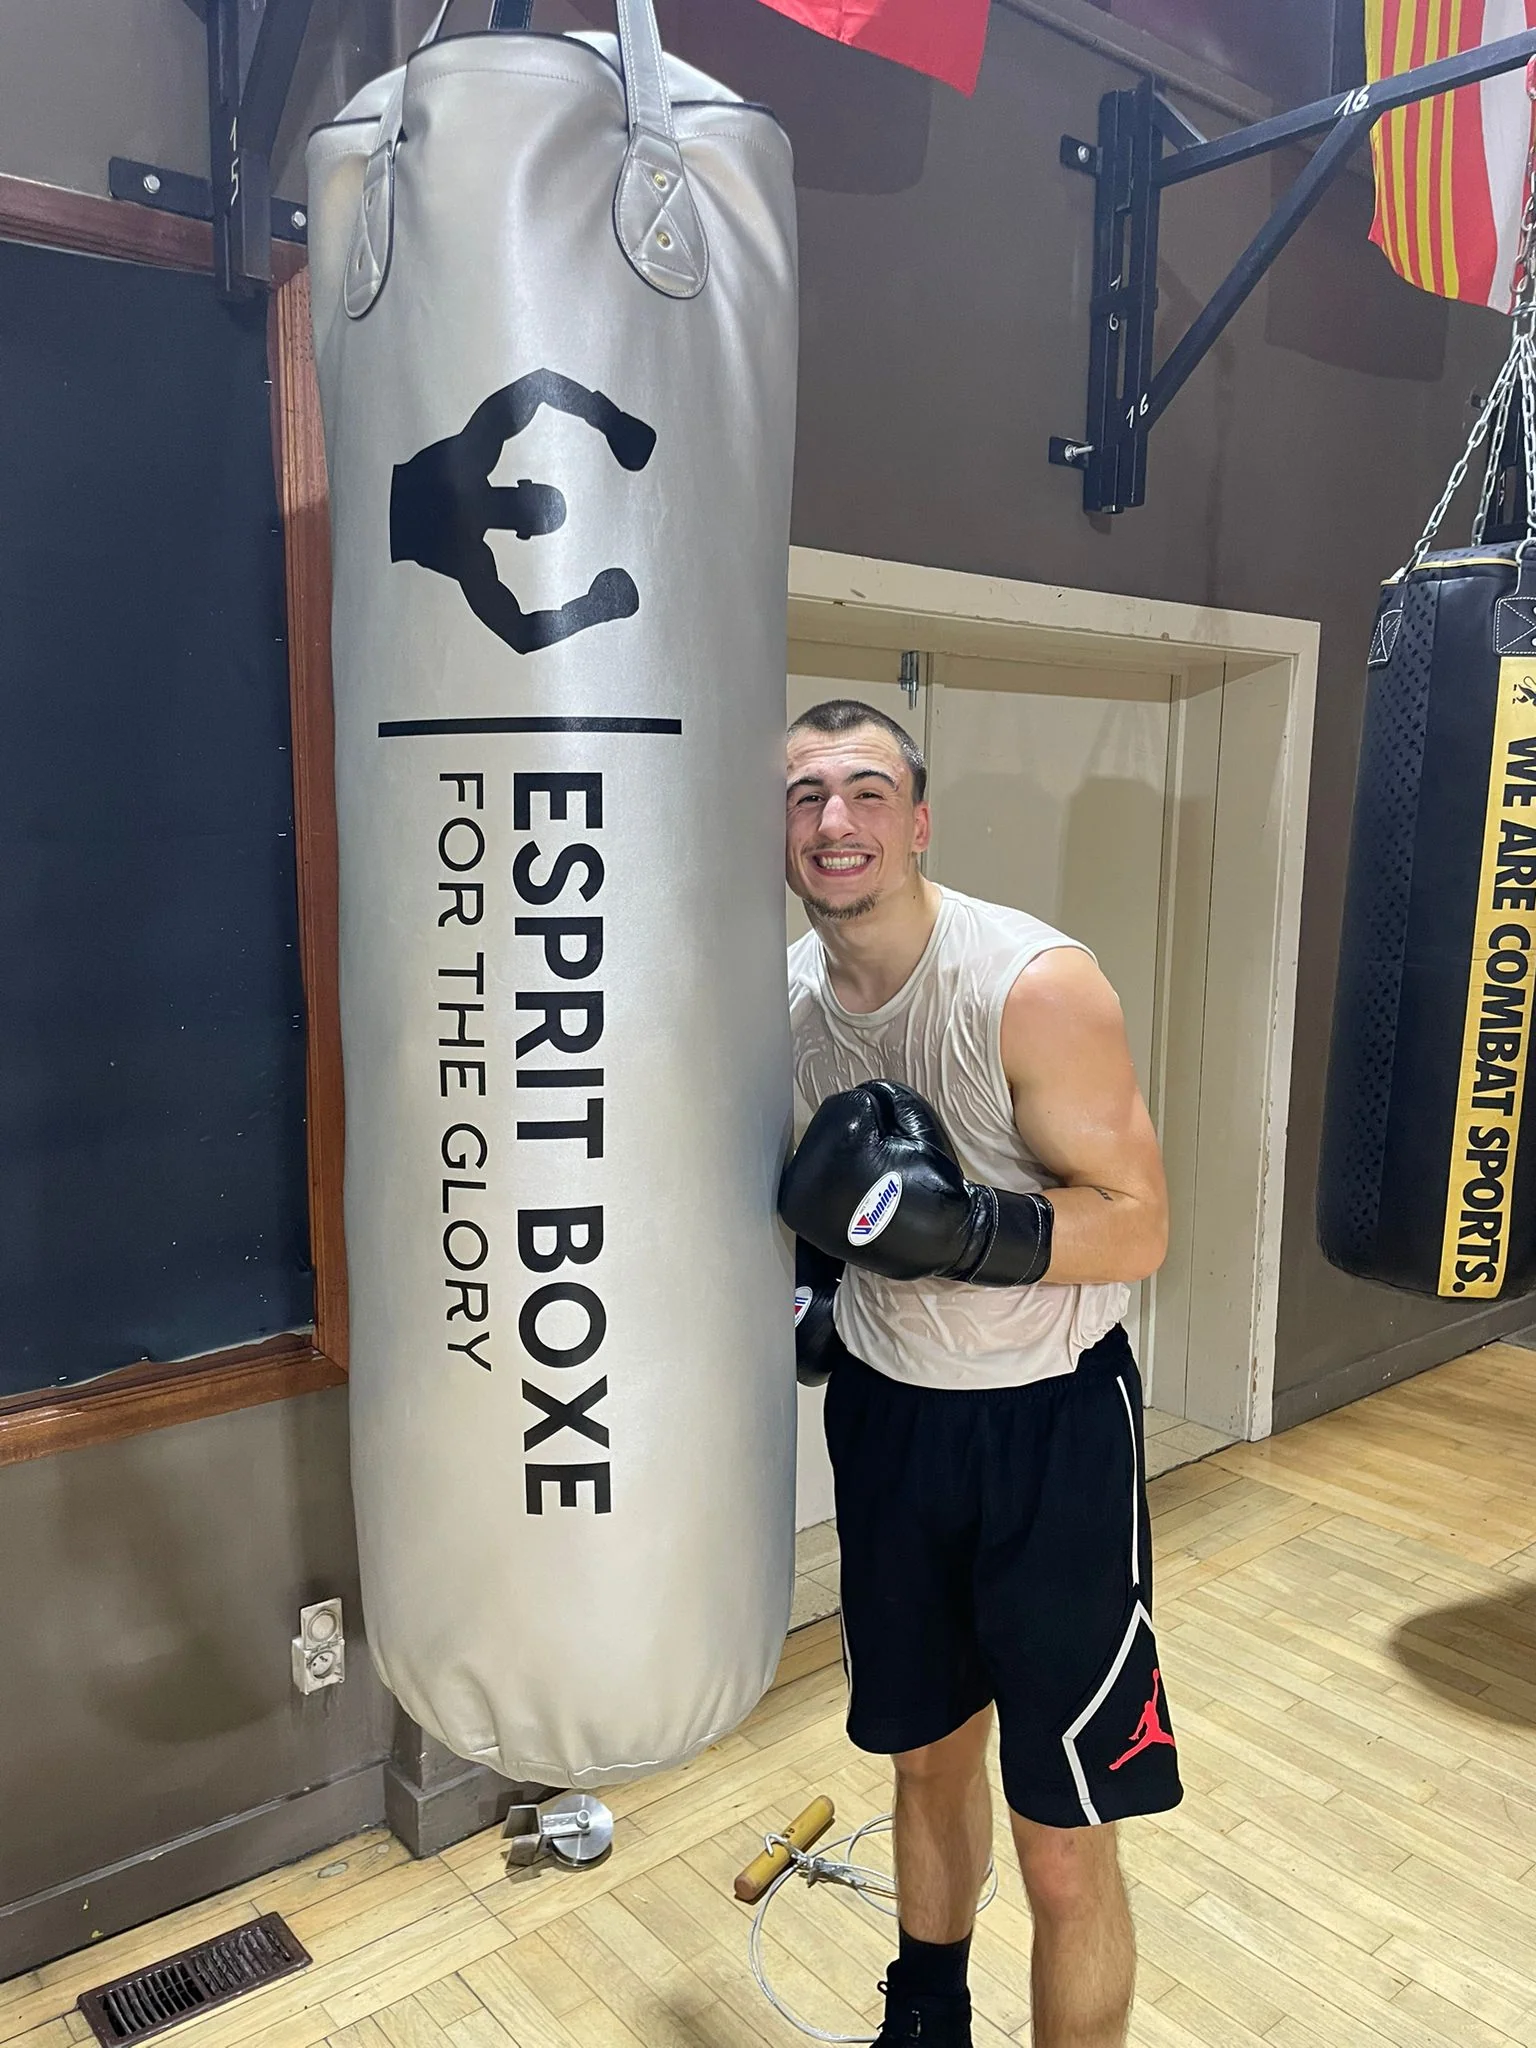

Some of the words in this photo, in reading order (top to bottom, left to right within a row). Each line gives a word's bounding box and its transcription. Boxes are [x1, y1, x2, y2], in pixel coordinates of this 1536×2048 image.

[1333, 84, 1370, 116] 16
[1126, 393, 1149, 428] 16
[438, 772, 486, 928] FOR
[1503, 737, 1536, 807] WE
[1492, 819, 1536, 911] ARE
[438, 952, 487, 1097] THE
[512, 773, 605, 1159] ESPRIT
[1472, 923, 1531, 1117] COMBAT
[440, 1123, 492, 1373] GLORY
[1453, 1126, 1510, 1293] SPORTS.
[517, 1206, 612, 1515] BOXE
